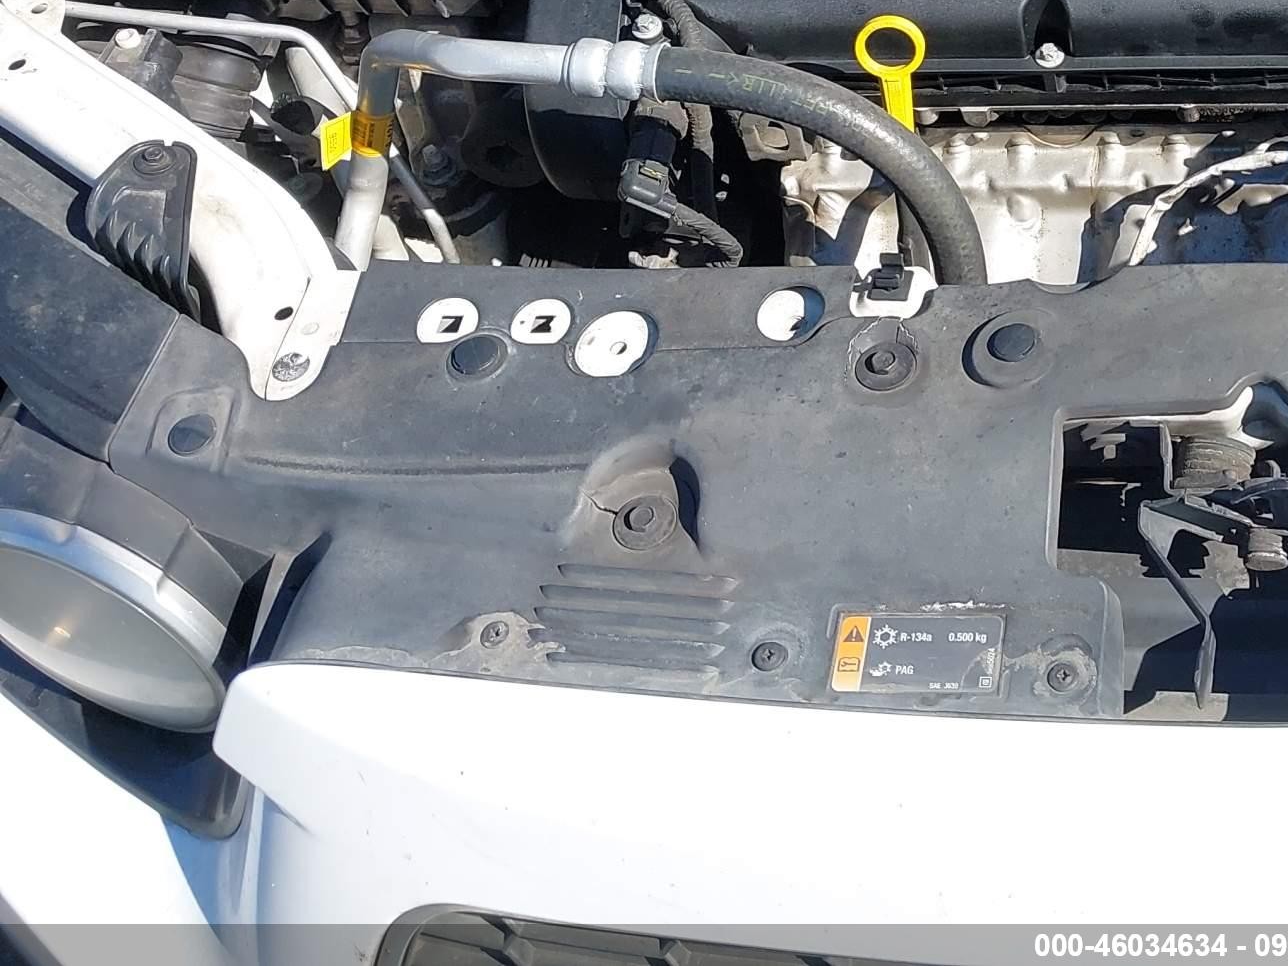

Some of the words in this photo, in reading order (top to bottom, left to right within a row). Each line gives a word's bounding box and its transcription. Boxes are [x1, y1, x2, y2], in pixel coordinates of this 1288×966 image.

[900, 632, 932, 642] R-134a
[948, 632, 974, 643] 0.500
[975, 632, 987, 644] kg
[895, 665, 914, 676] PAG
